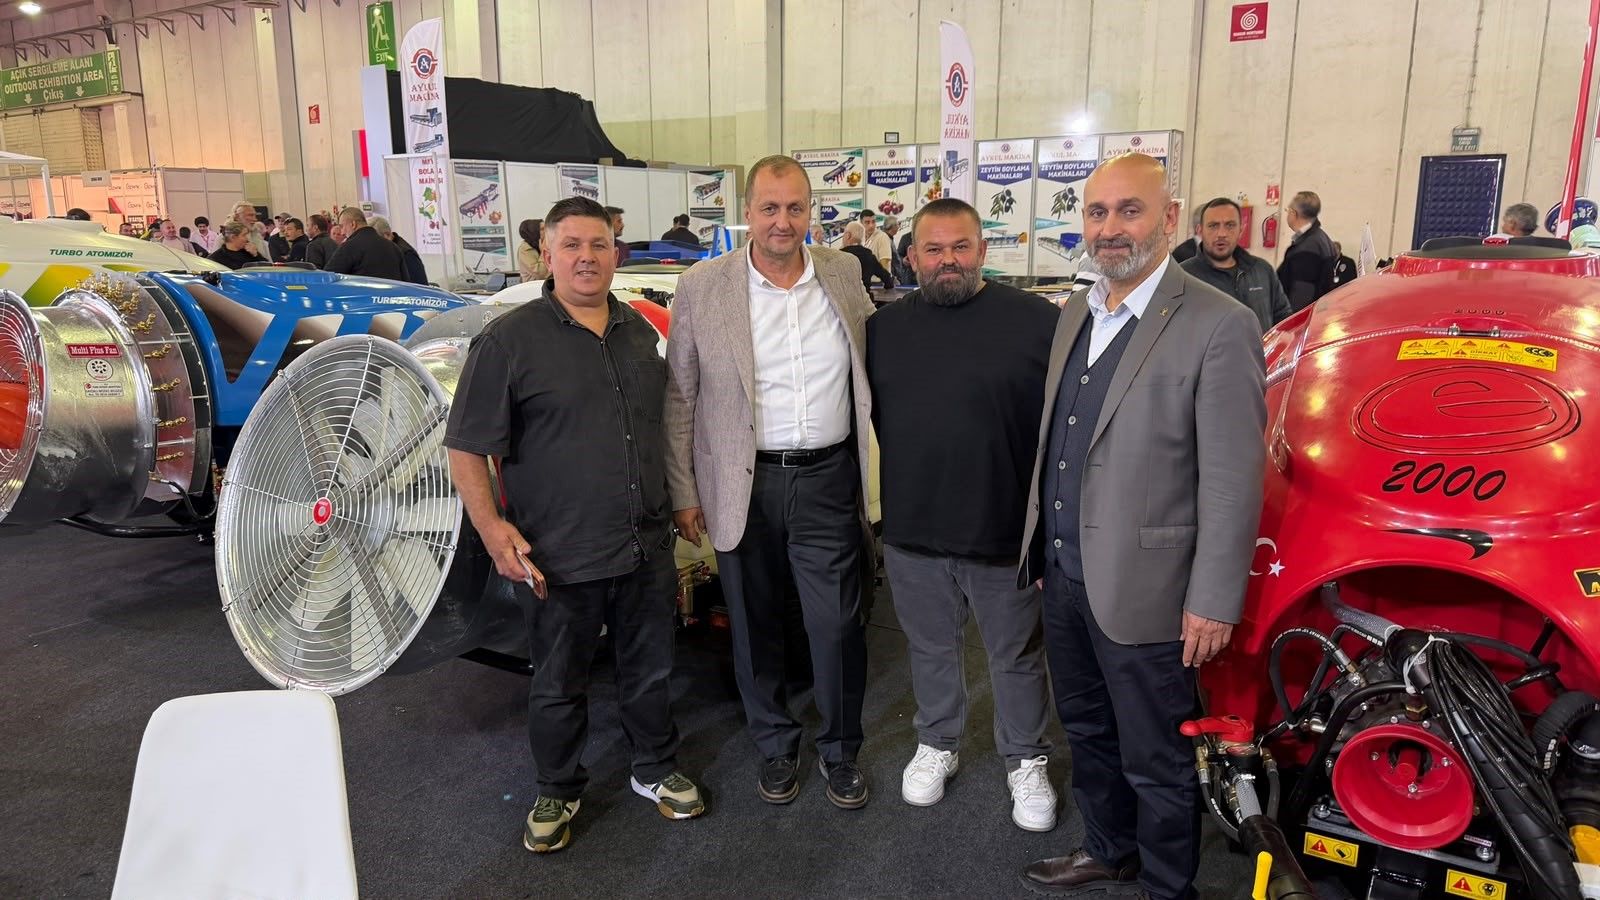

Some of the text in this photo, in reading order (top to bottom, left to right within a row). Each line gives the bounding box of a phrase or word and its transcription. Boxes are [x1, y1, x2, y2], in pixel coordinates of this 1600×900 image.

[376, 52, 388, 63] EXIT
[11, 57, 94, 82] AÇIK SERGİLEME ALANI
[5, 70, 104, 94] OUTDOOR EXHIBITION AREA
[43, 89, 64, 104] Çıkış
[1002, 165, 1030, 173] BOYLAMA
[1064, 162, 1095, 170] BOYLAMA
[987, 172, 1023, 180] MAKİNALARI
[1047, 170, 1087, 178] MAKİNALARI
[50, 249, 83, 257] TURBO
[371, 296, 402, 305] TURBO
[71, 346, 117, 355] Multi Plus Fan
[1381, 459, 1506, 501] 2000
